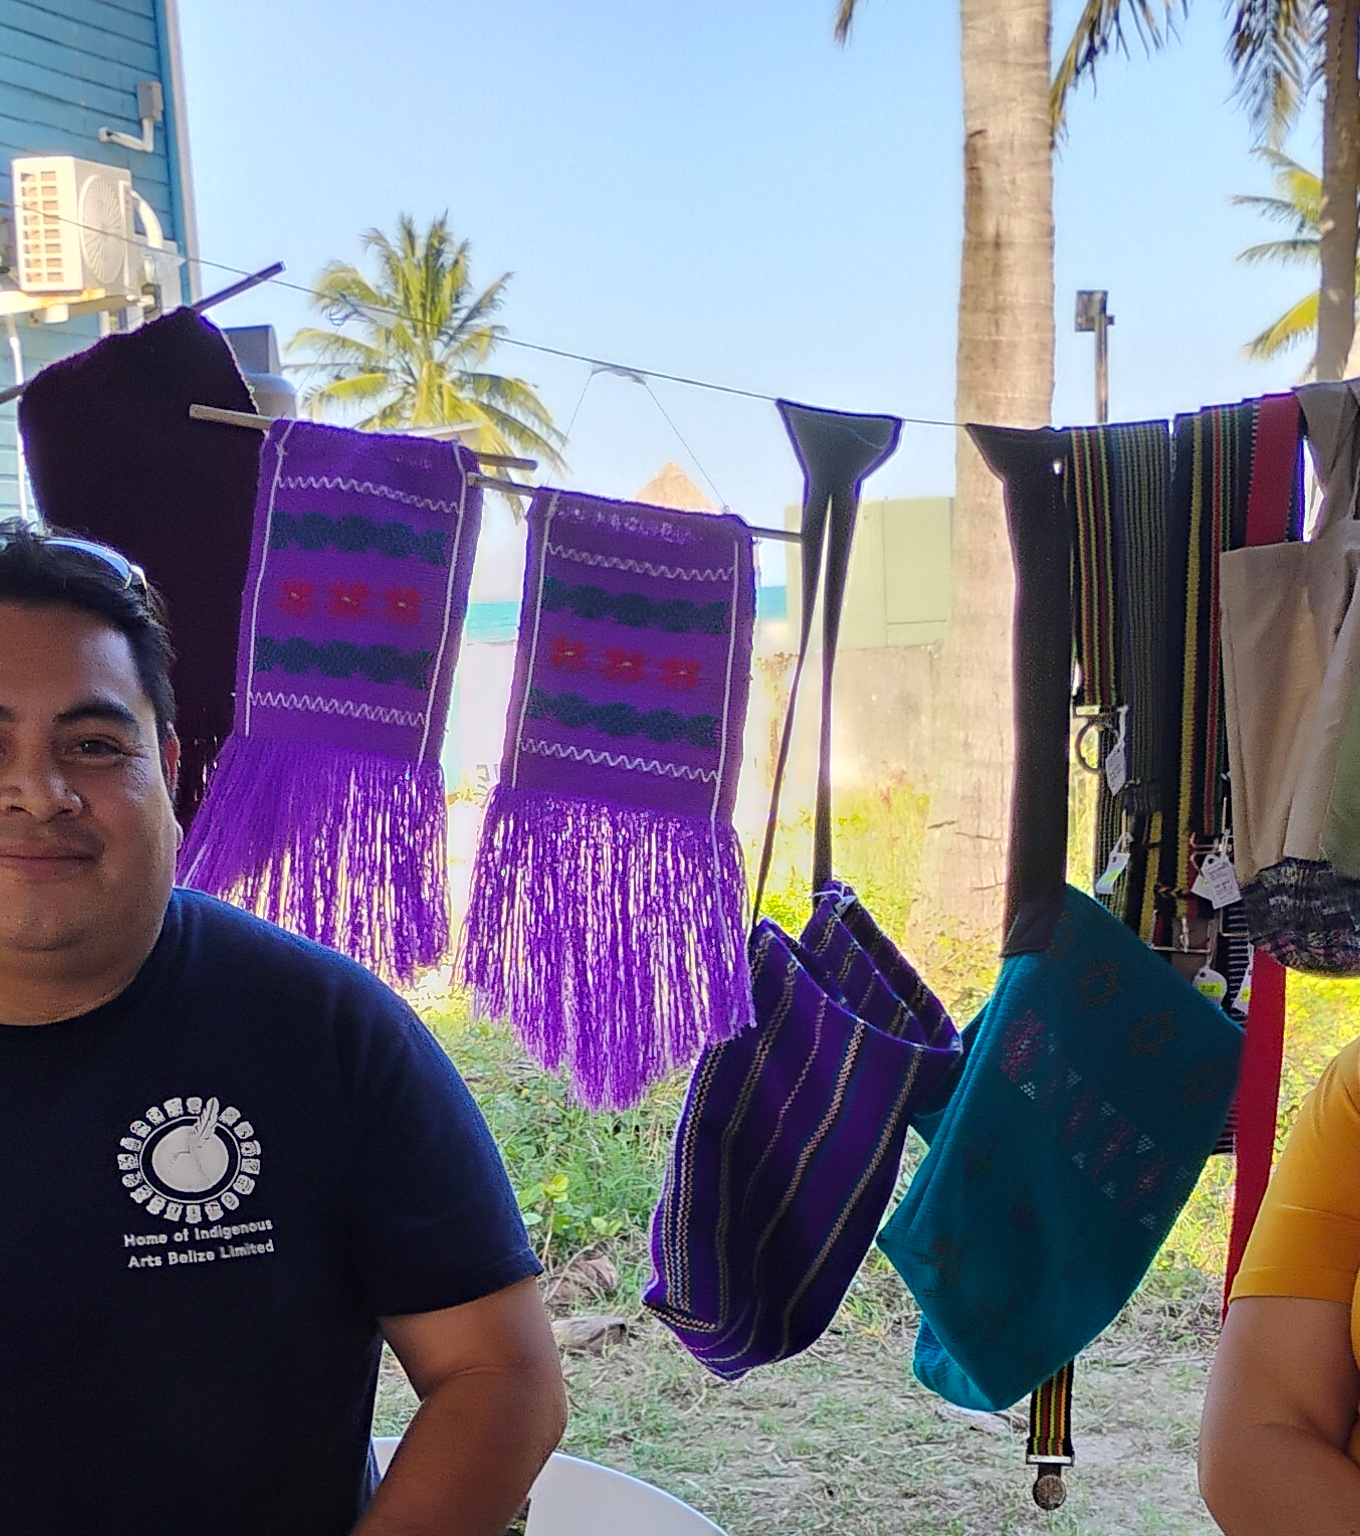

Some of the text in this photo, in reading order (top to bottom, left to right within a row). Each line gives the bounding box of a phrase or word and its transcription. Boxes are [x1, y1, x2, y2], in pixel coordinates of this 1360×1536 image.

[123, 1219, 273, 1248] Home of Indigenous
[127, 1239, 274, 1269] Arts Belize Limited
